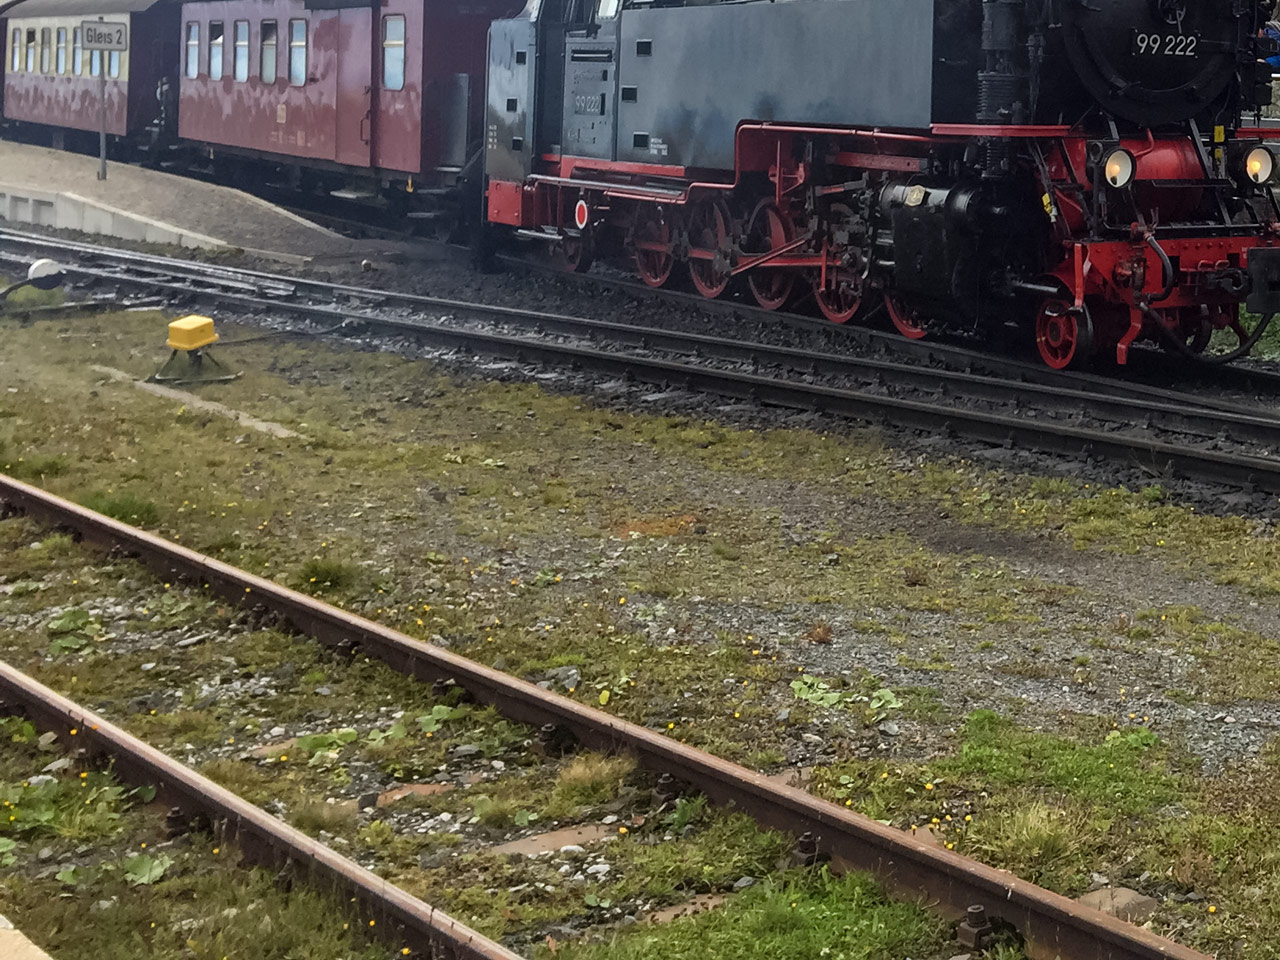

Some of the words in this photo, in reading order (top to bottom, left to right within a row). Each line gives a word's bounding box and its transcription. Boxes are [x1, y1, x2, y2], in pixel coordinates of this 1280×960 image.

[86, 27, 113, 44] Gleis
[116, 28, 122, 45] 2
[1137, 33, 1160, 54] 99
[1164, 35, 1197, 56] 222
[575, 95, 586, 111] 99
